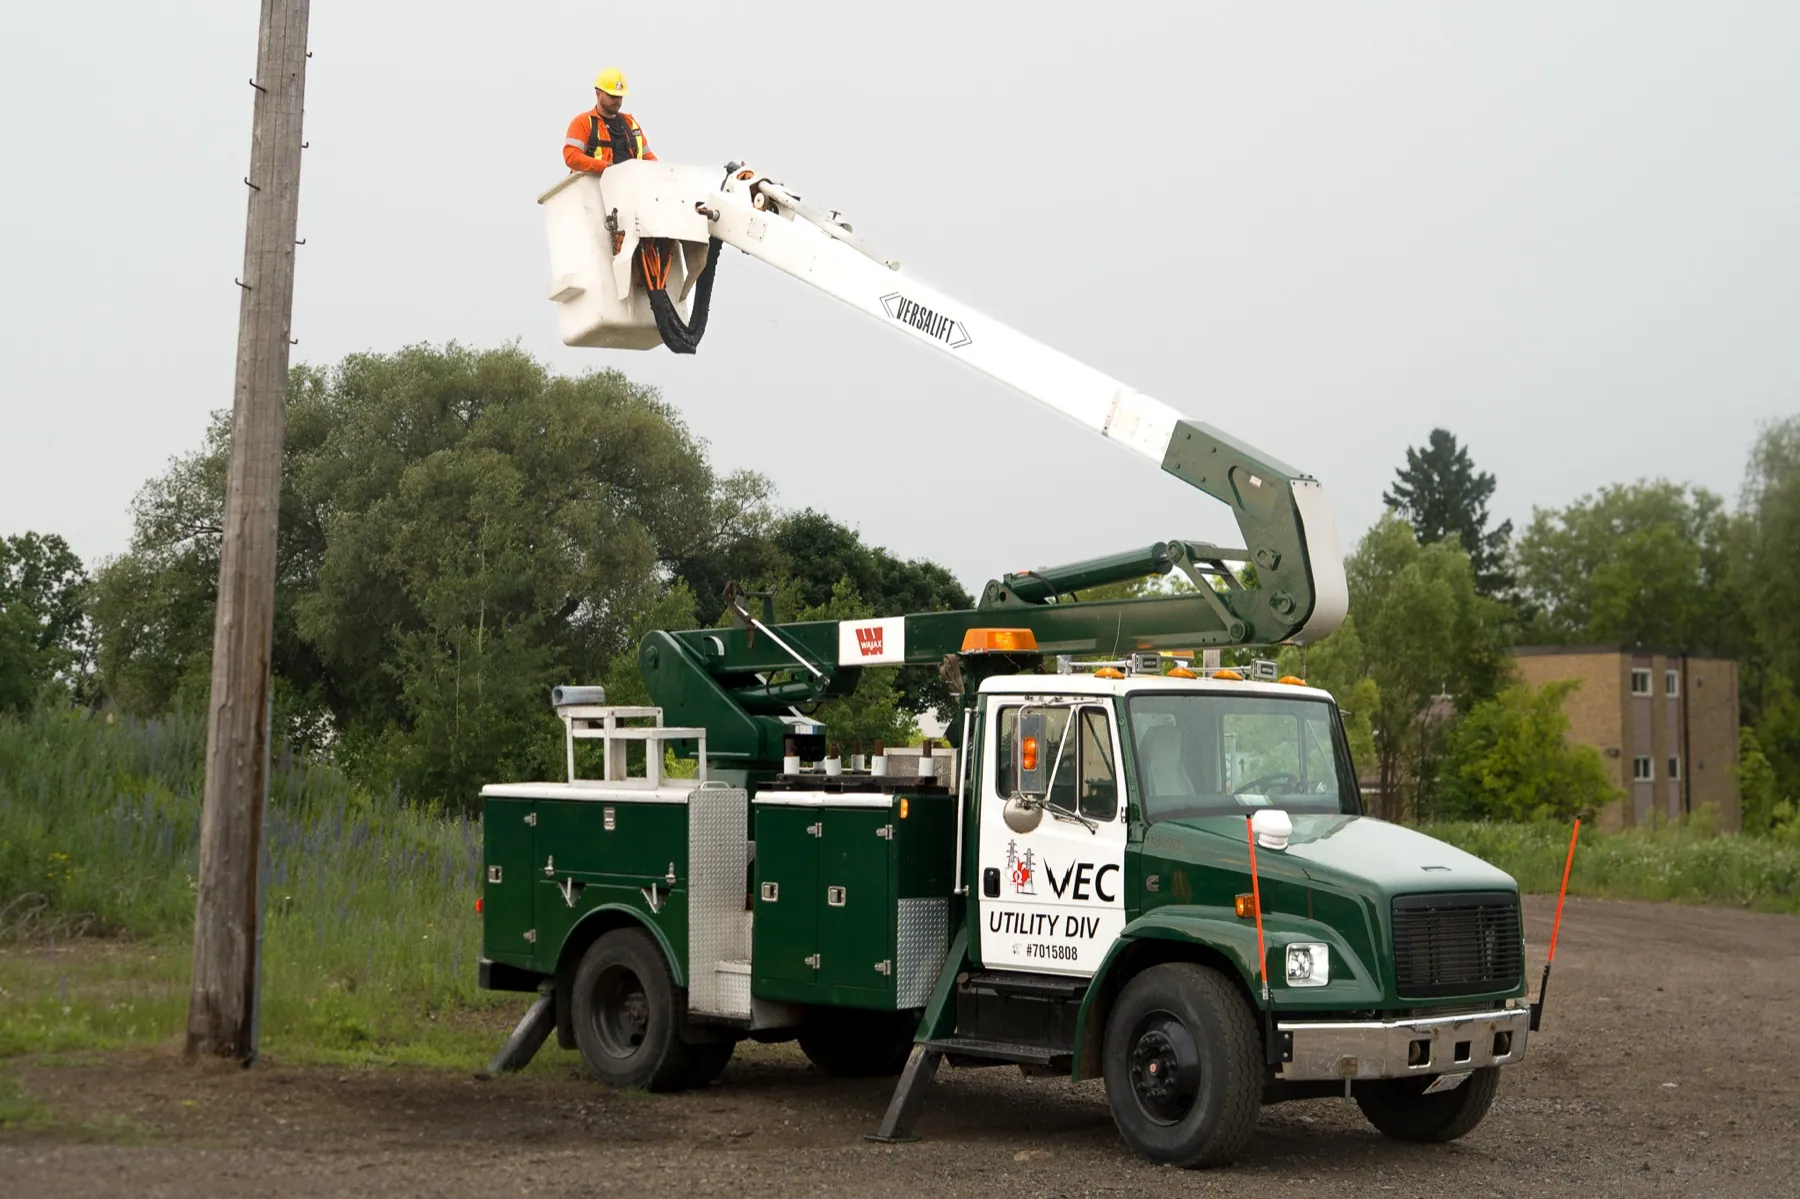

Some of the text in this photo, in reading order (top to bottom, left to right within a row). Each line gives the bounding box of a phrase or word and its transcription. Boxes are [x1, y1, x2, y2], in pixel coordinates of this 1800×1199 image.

[896, 296, 955, 343] VERSALIFT
[860, 640, 883, 650] WAJAX
[1043, 857, 1120, 902] VEC
[990, 911, 1100, 939] UTILITY DIV
[1026, 943, 1078, 961] #7015808
